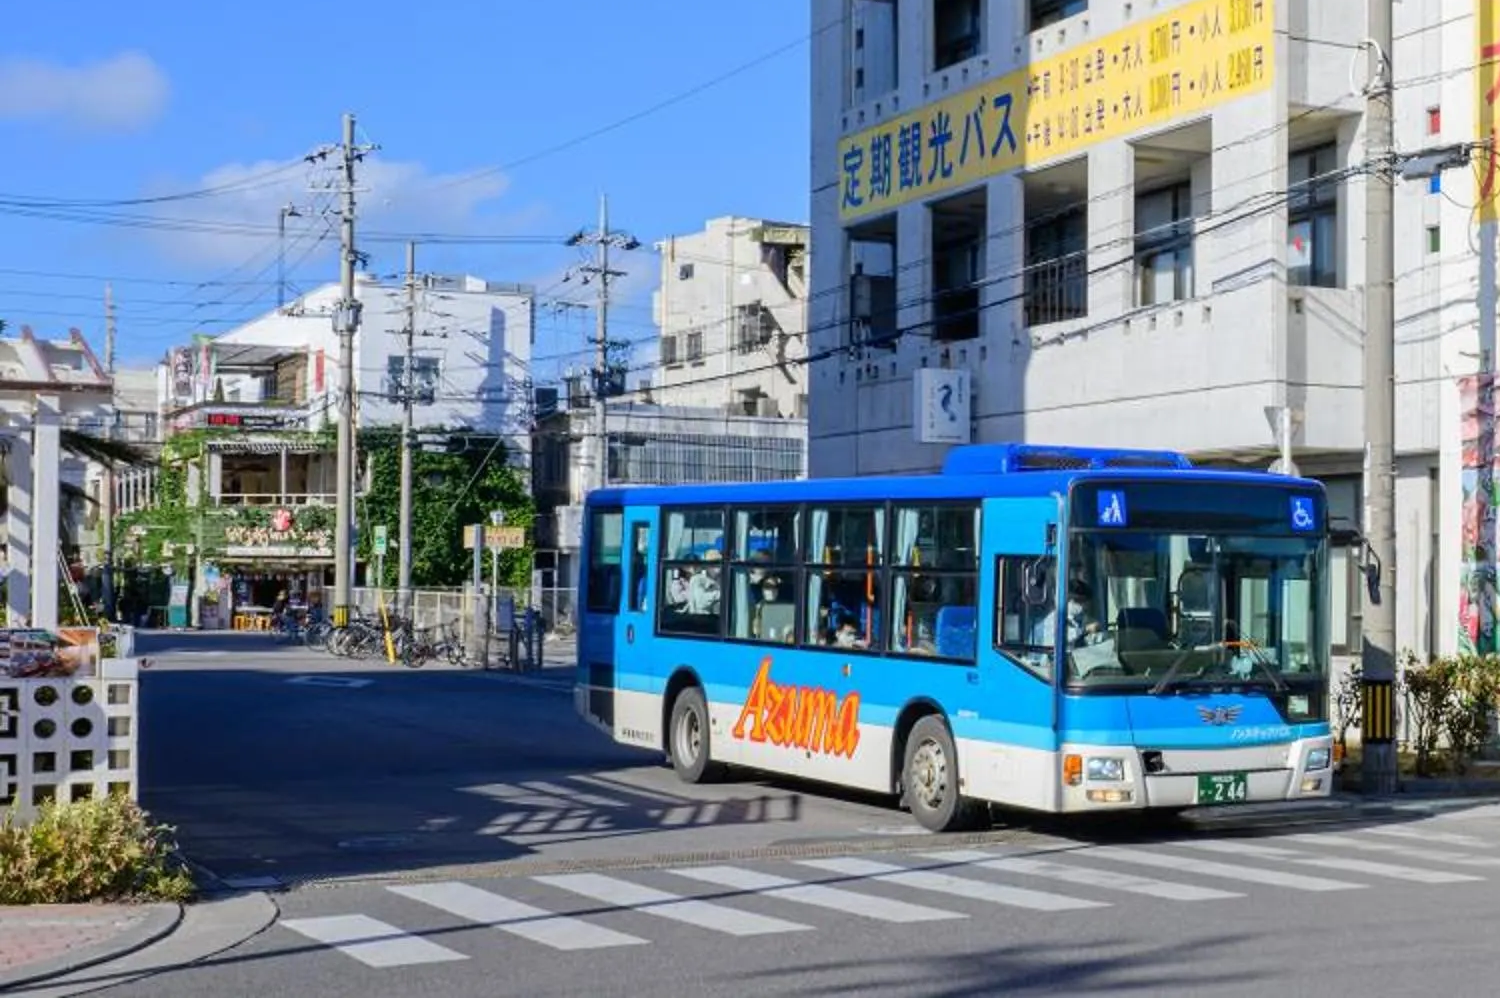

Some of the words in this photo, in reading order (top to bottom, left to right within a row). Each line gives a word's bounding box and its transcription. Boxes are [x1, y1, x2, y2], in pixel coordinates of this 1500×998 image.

[841, 92, 1018, 211] 定期観光バス
[734, 656, 862, 760] Azuma
